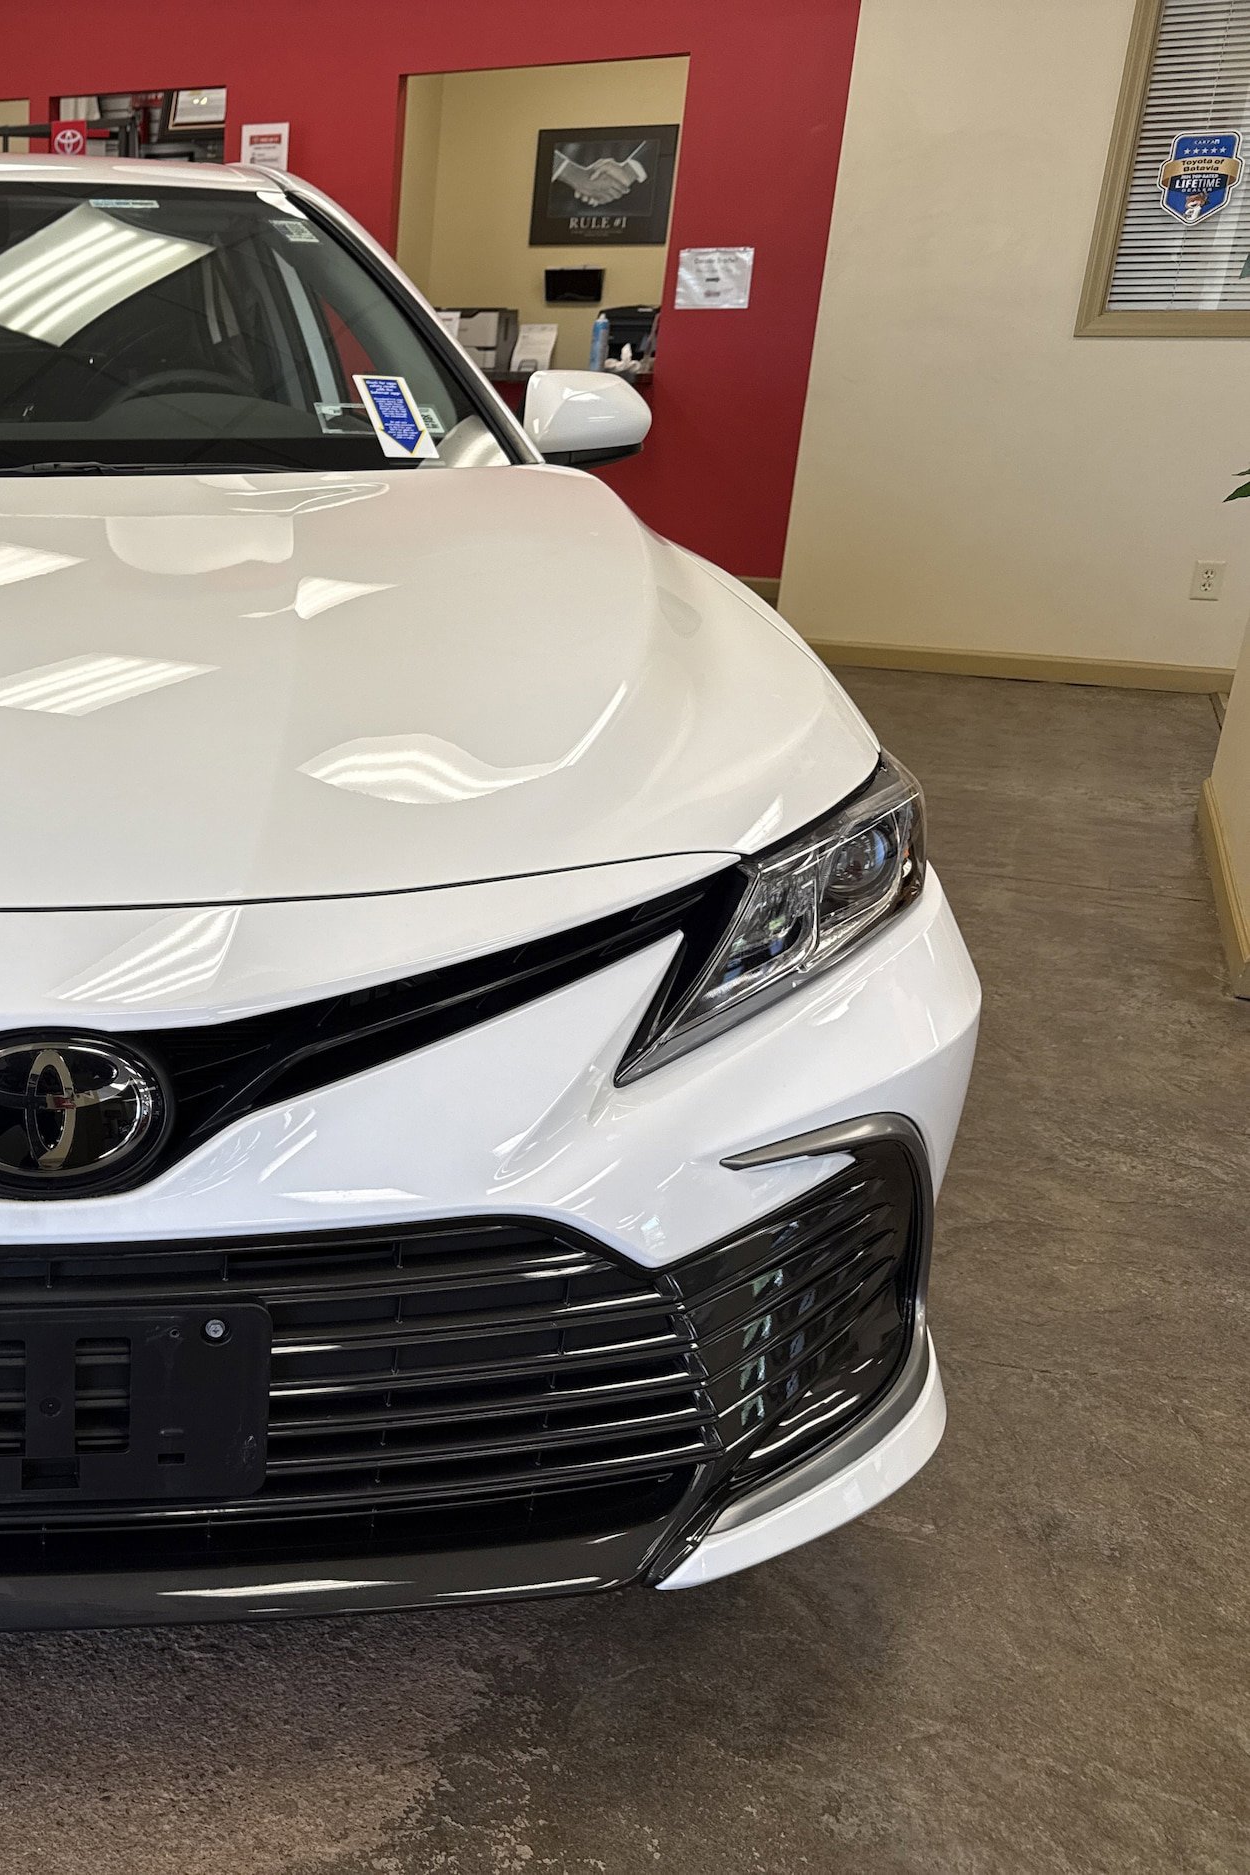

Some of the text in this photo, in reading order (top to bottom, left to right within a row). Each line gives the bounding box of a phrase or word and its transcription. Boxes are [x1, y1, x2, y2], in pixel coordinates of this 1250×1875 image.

[1181, 158, 1213, 166] Toyota
[1175, 178, 1221, 189] LIFETIME
[569, 216, 628, 229] RULE #1
